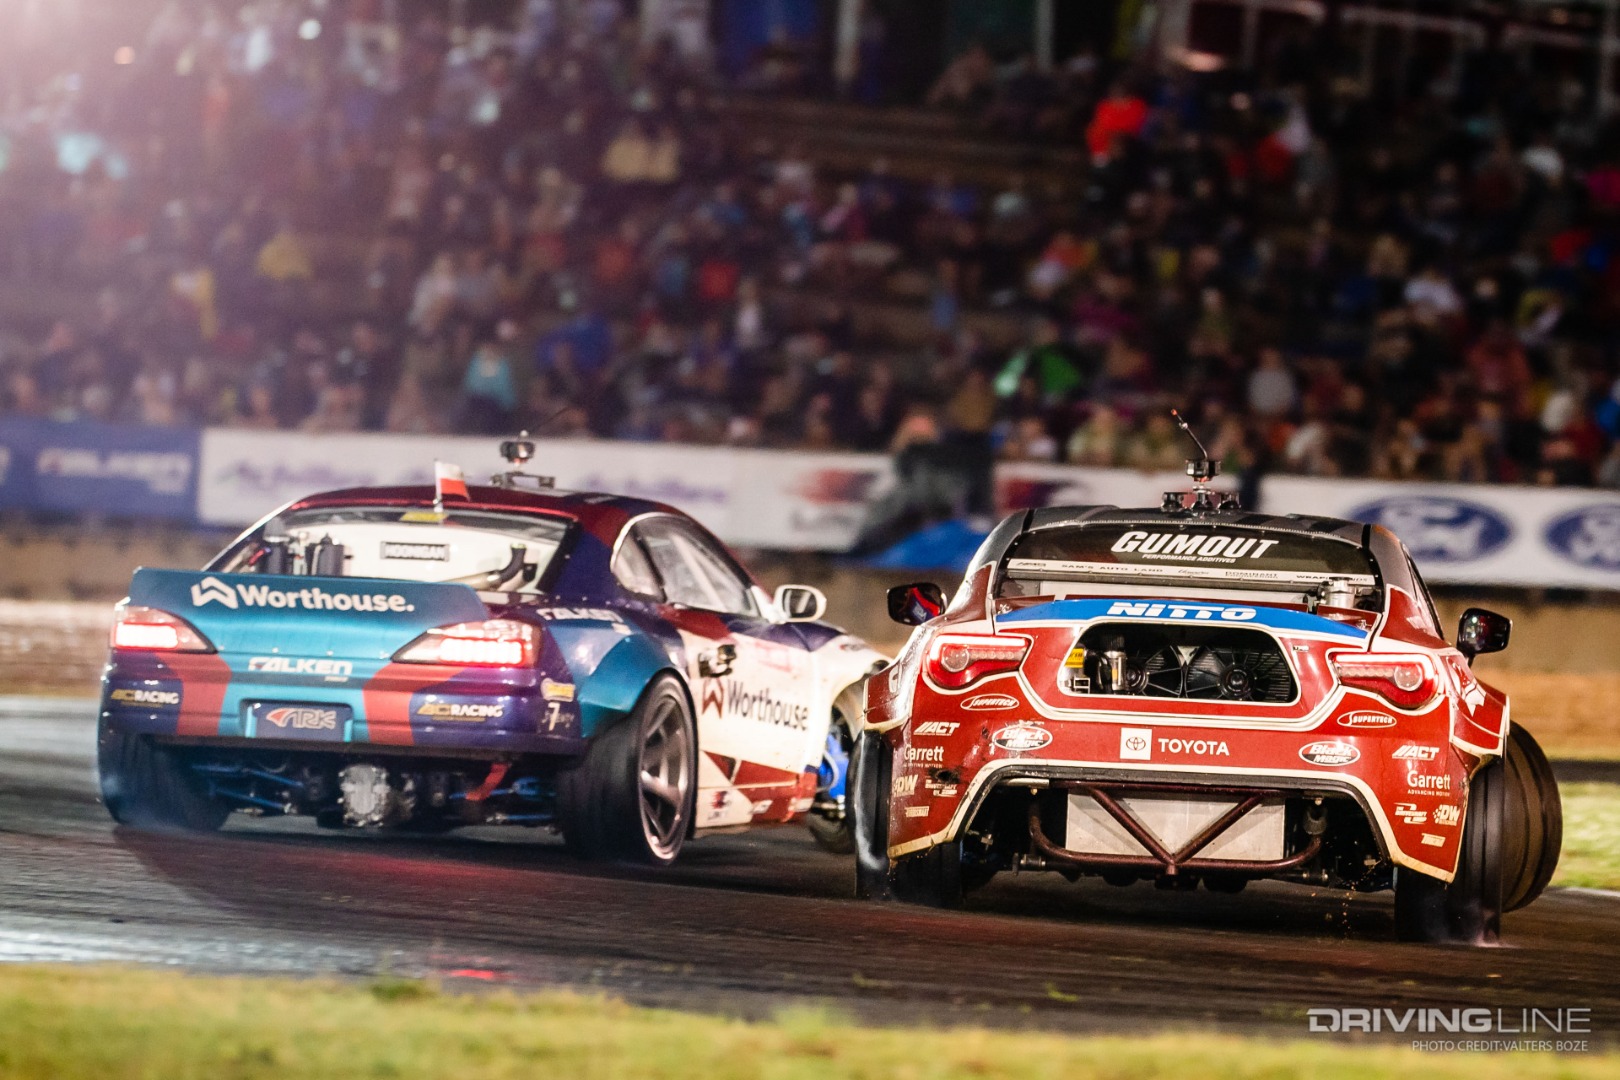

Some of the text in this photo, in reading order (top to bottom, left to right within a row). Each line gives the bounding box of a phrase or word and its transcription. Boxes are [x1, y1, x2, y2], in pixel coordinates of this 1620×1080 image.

[1111, 530, 1279, 559] GUMOUT
[1142, 553, 1197, 563] PERFORMANCE
[1107, 602, 1257, 620] NITTO
[248, 656, 353, 675] FALKEN
[727, 679, 809, 732] Worthouse
[968, 698, 1017, 710] SUPERTECH
[1348, 713, 1393, 726] SUPERTECH
[1002, 727, 1045, 741] Black
[903, 745, 944, 763] Garrett
[1157, 738, 1230, 756] TOYOTA
[1309, 743, 1353, 756] Black
[1313, 754, 1352, 764] Magic
[1407, 770, 1451, 790] Garrett
